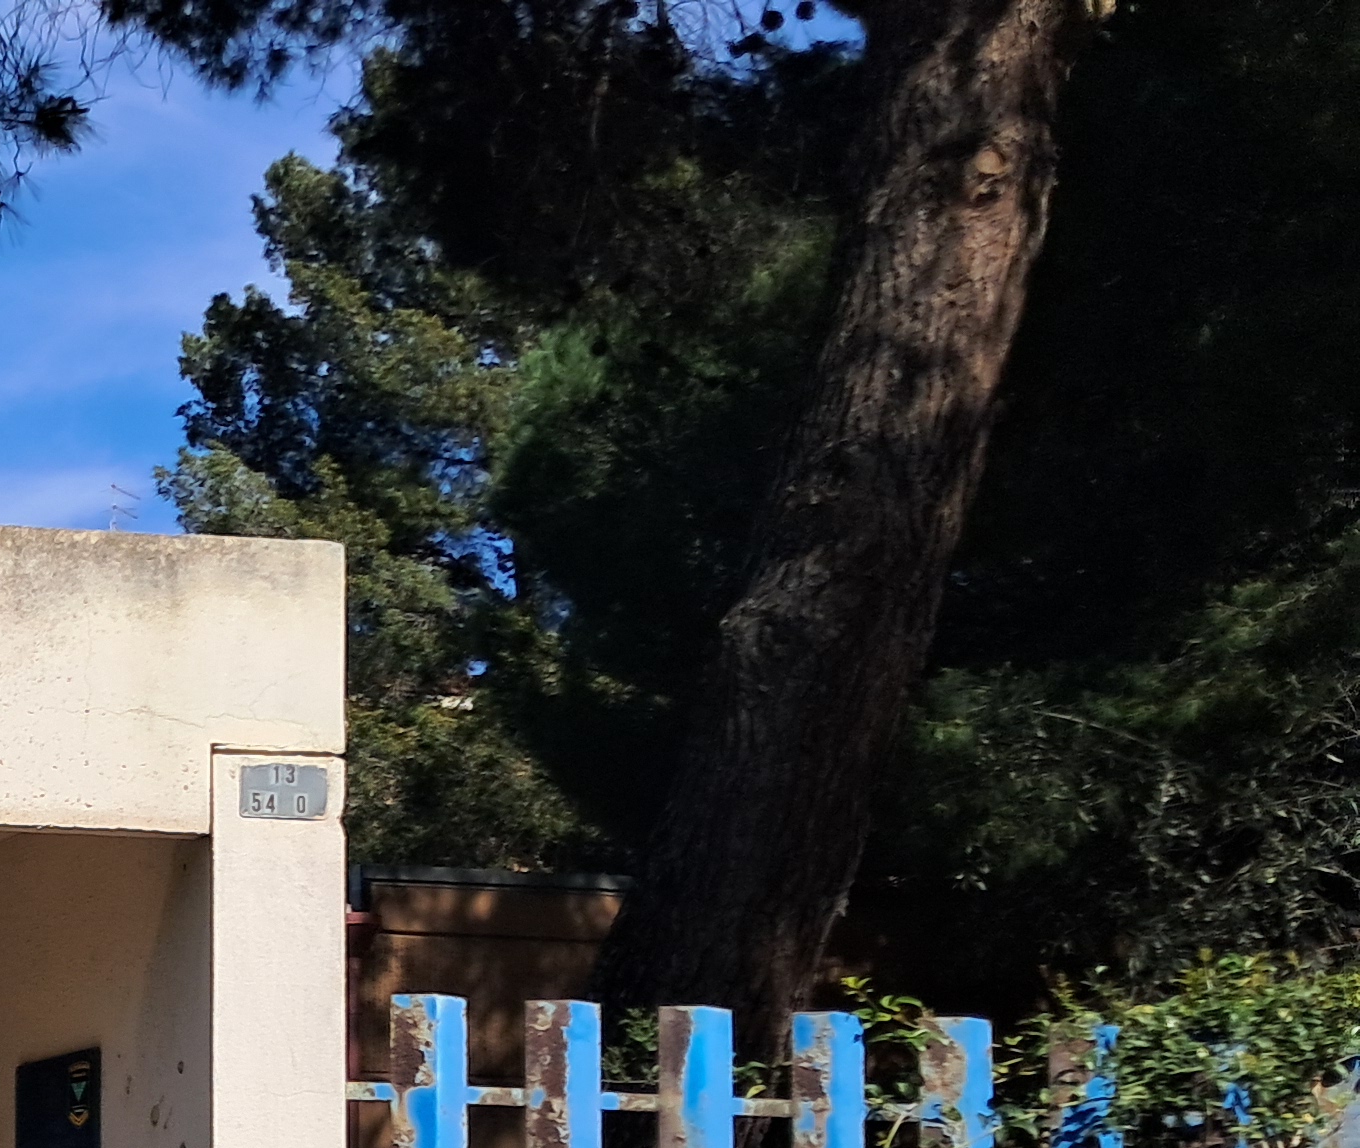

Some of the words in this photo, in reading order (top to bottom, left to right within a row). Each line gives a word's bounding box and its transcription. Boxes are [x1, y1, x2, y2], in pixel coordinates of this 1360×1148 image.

[272, 764, 296, 785] 13
[251, 792, 276, 814] 54
[296, 795, 307, 814] 0
